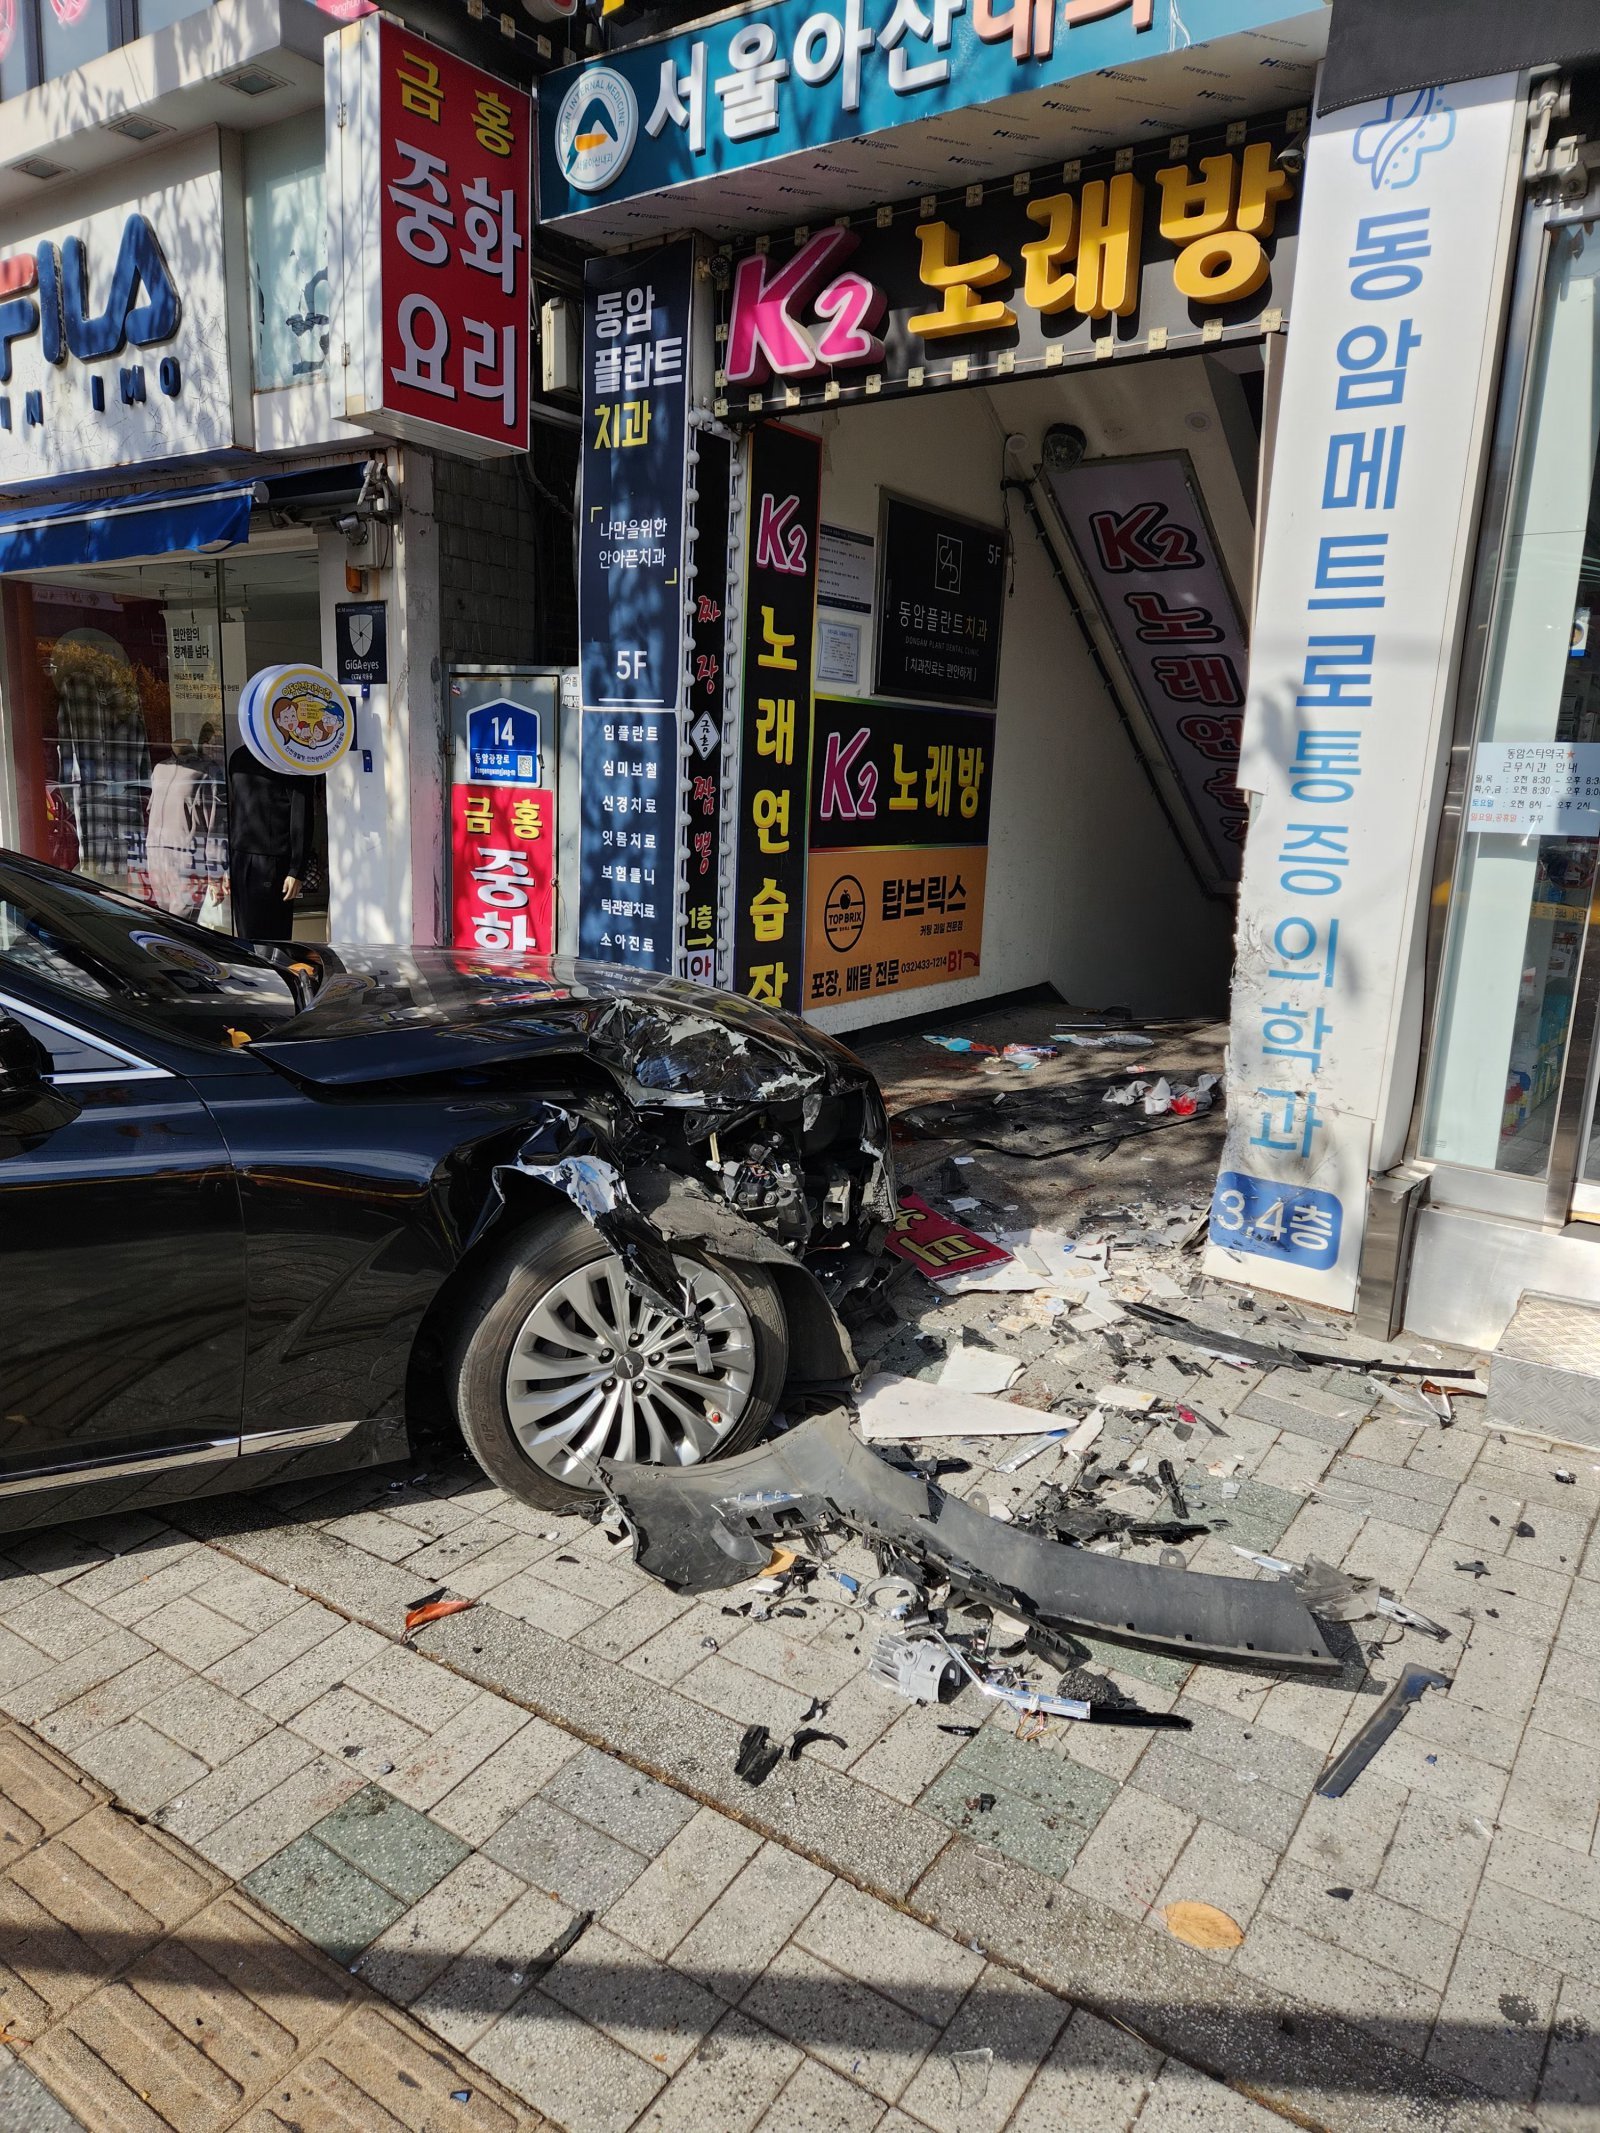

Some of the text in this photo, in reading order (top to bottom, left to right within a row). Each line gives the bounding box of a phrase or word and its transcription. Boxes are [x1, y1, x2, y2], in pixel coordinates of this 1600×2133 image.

[645, 0, 1152, 153] 서울아산내
[604, 82, 625, 127] MEDICINE
[386, 139, 522, 295] 중화
[725, 142, 1295, 386] K2 노래방
[0, 213, 182, 382] FILA
[594, 285, 656, 339] 동암
[390, 293, 517, 427] 요리
[593, 336, 683, 395] 플란트
[593, 400, 652, 451] 치과
[600, 516, 668, 541] 나만을위한
[756, 493, 808, 576] K2
[1089, 501, 1205, 573] K2
[598, 548, 667, 570] 안아픈치과
[173, 627, 200, 641] 편안함의
[899, 601, 988, 642] 동암플란트치과
[174, 645, 209, 659] 경계를 넘다
[696, 594, 722, 695] 짜장
[616, 650, 648, 681] 5F
[910, 657, 973, 681] 치과진료는 편안하게
[1250, 207, 1432, 1159] 동암메트로통증의학과
[491, 716, 515, 746] 14
[603, 724, 659, 742] 임플란트
[700, 719, 712, 753] 금홍
[475, 753, 510, 765] 동암광장로
[1503, 761, 1578, 774] 근무시간 안내
[1507, 748, 1565, 760] 동암스타약국
[602, 760, 657, 779] 심미보철
[820, 728, 985, 821] K2 노래방
[1514, 775, 1528, 784] 오전
[1532, 776, 1551, 785] 8:30
[1566, 776, 1581, 785] 오후
[1585, 776, 1600, 785] 8:3
[602, 796, 657, 814] 신경치료
[1472, 799, 1591, 810] 토요일 오전 8시 오후 2시
[1512, 786, 1528, 795] 오전
[1532, 786, 1551, 795] 8:30
[1566, 787, 1581, 796] 오후
[747, 605, 802, 1009] 노래연습장
[602, 830, 657, 849] 잇몸치료
[601, 865, 655, 885] 보험틀니
[601, 898, 655, 919] 턱관절치료
[882, 874, 967, 921] 탑브릭스
[689, 904, 713, 930] 1층
[946, 920, 964, 933] 전문점
[600, 932, 655, 952] 소아진료
[846, 964, 872, 993] 배달
[875, 958, 899, 988] 전문
[901, 956, 947, 974] 032)433-1214
[948, 949, 962, 973] B1
